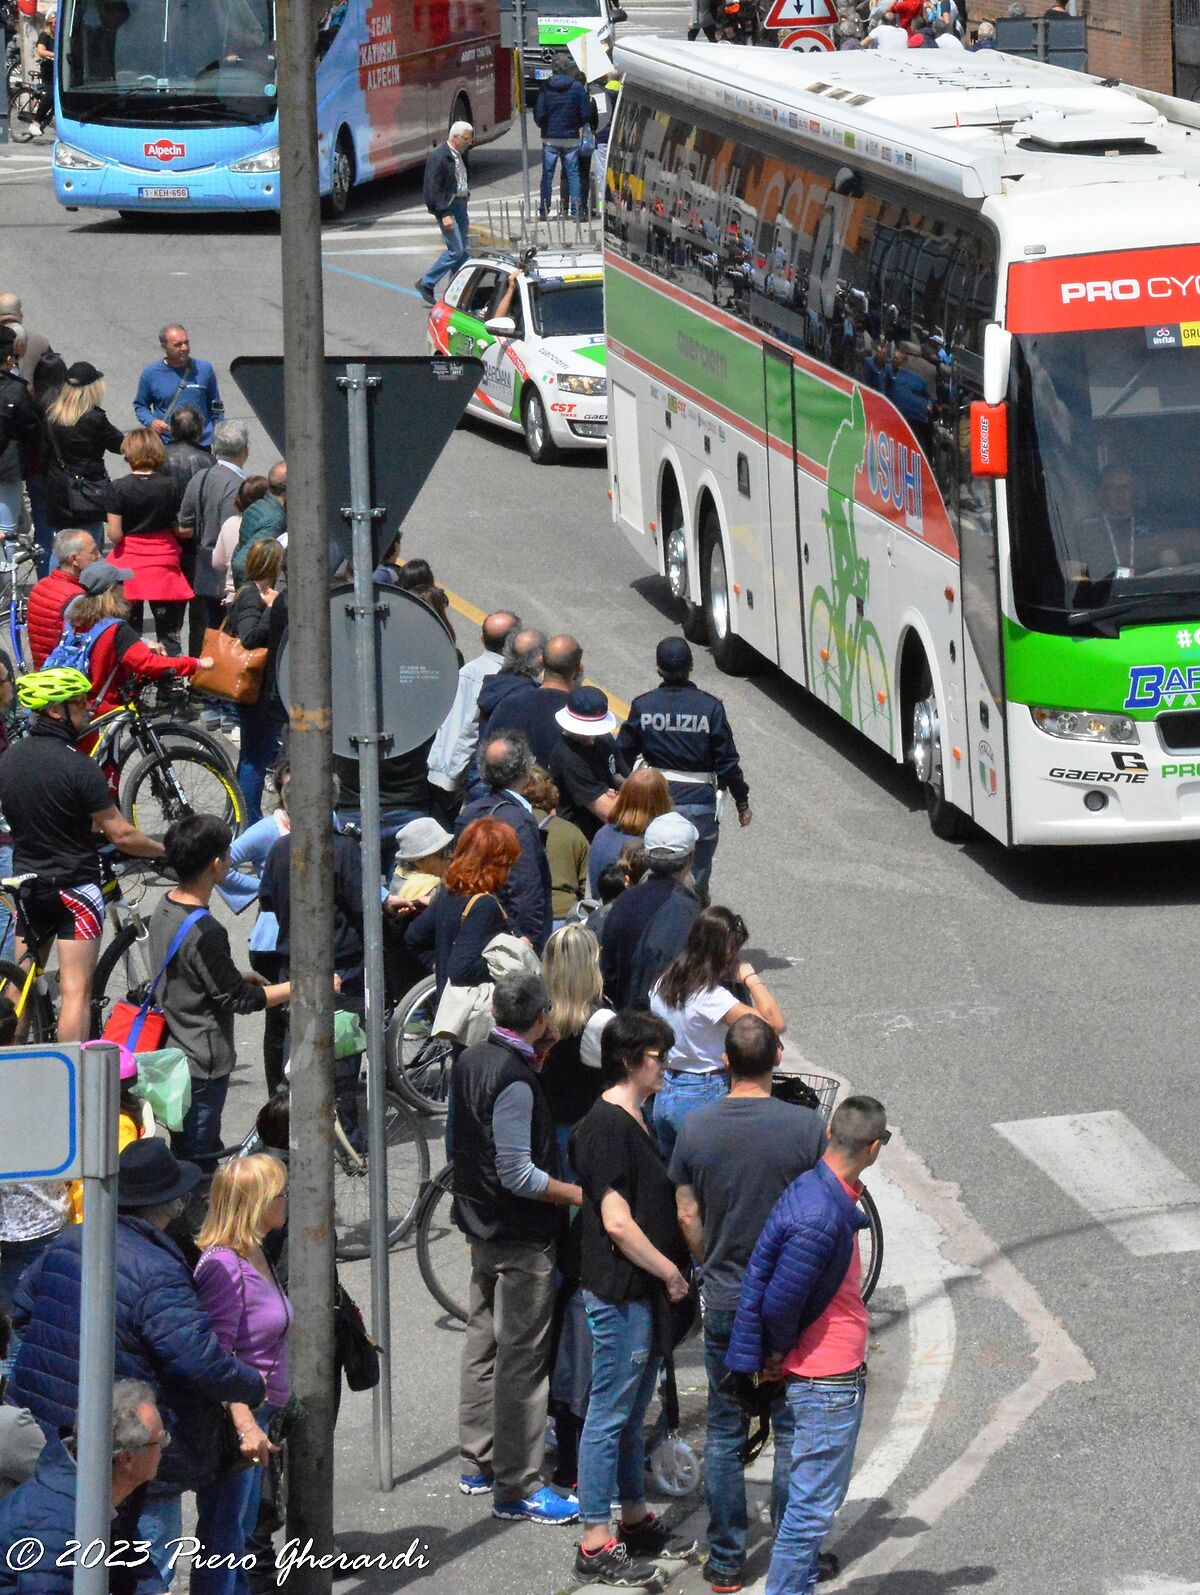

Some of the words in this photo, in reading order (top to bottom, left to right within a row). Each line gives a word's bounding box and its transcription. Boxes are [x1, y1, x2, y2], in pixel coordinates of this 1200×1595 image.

[371, 14, 392, 37] TEAM
[361, 39, 398, 67] KATUSHA
[368, 63, 400, 92] ALPECIN
[147, 145, 182, 157] Alpecin
[1060, 278, 1140, 305] PRO
[549, 402, 577, 413] CST
[877, 431, 923, 521] SUHI
[640, 713, 710, 734] POLIZIA
